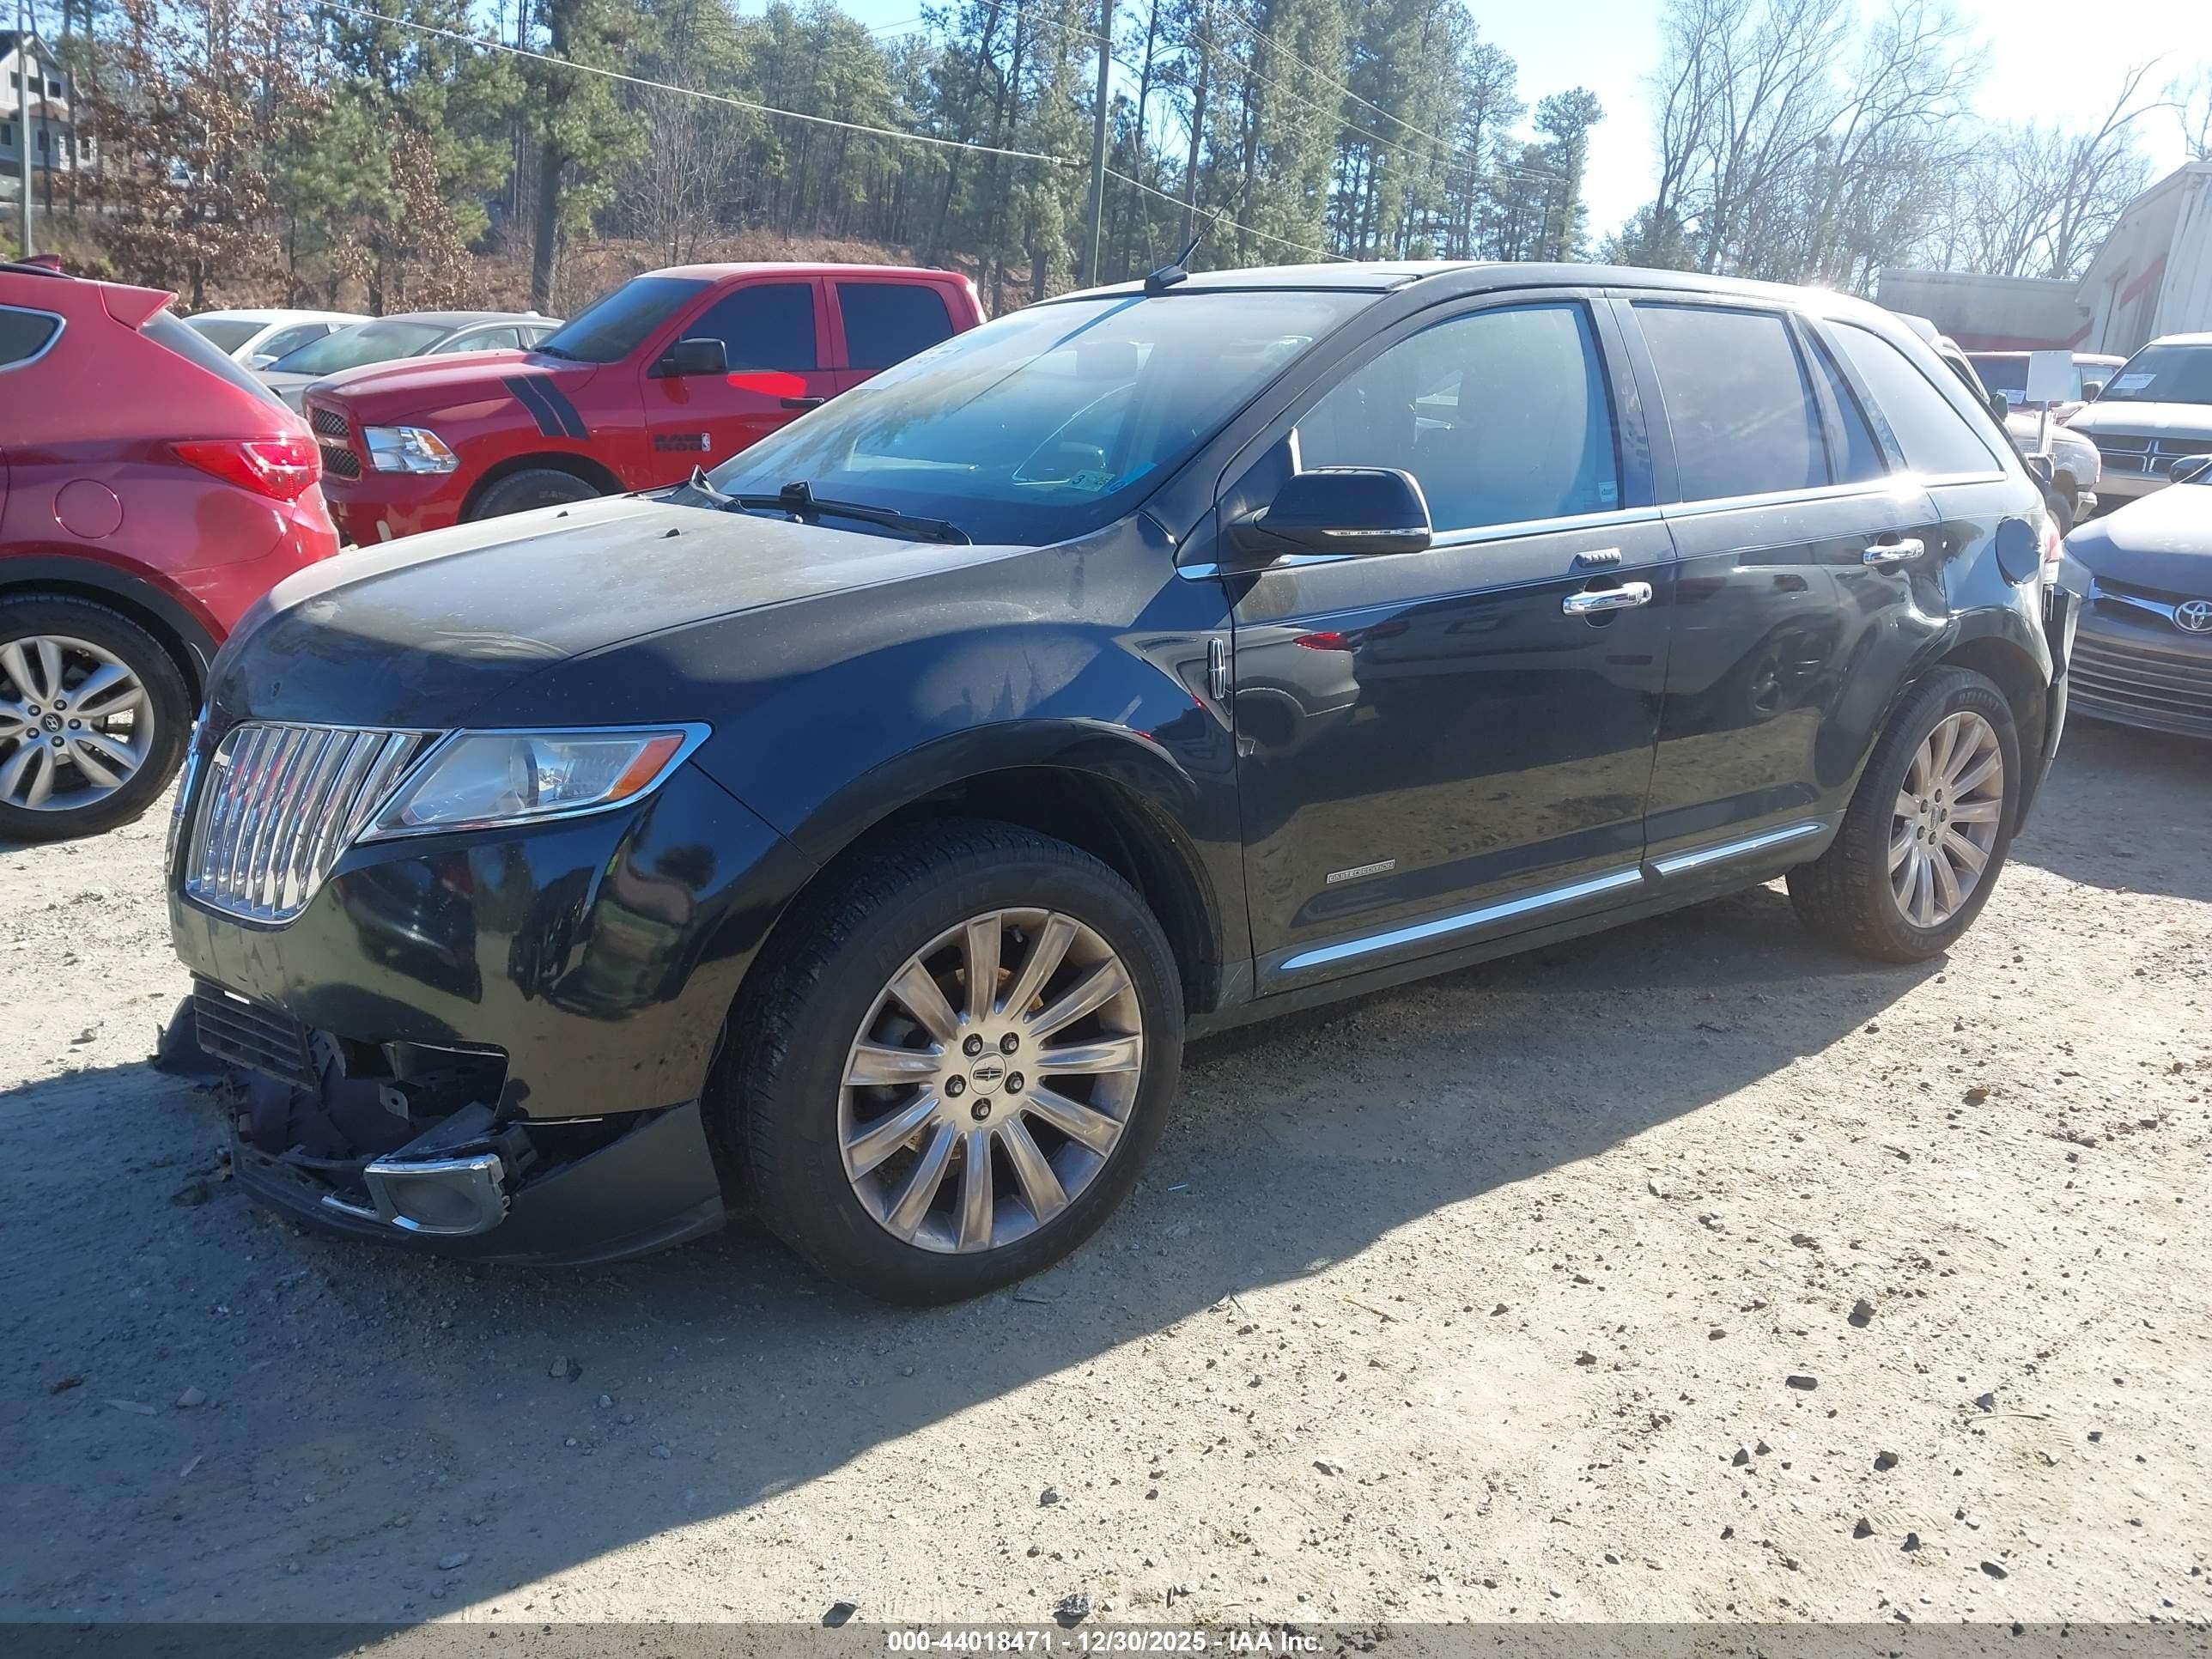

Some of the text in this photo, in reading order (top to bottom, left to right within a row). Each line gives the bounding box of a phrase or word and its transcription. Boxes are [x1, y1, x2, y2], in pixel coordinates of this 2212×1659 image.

[1072, 474, 1086, 484] 3
[1328, 862, 1394, 882] LIMITED EDITION
